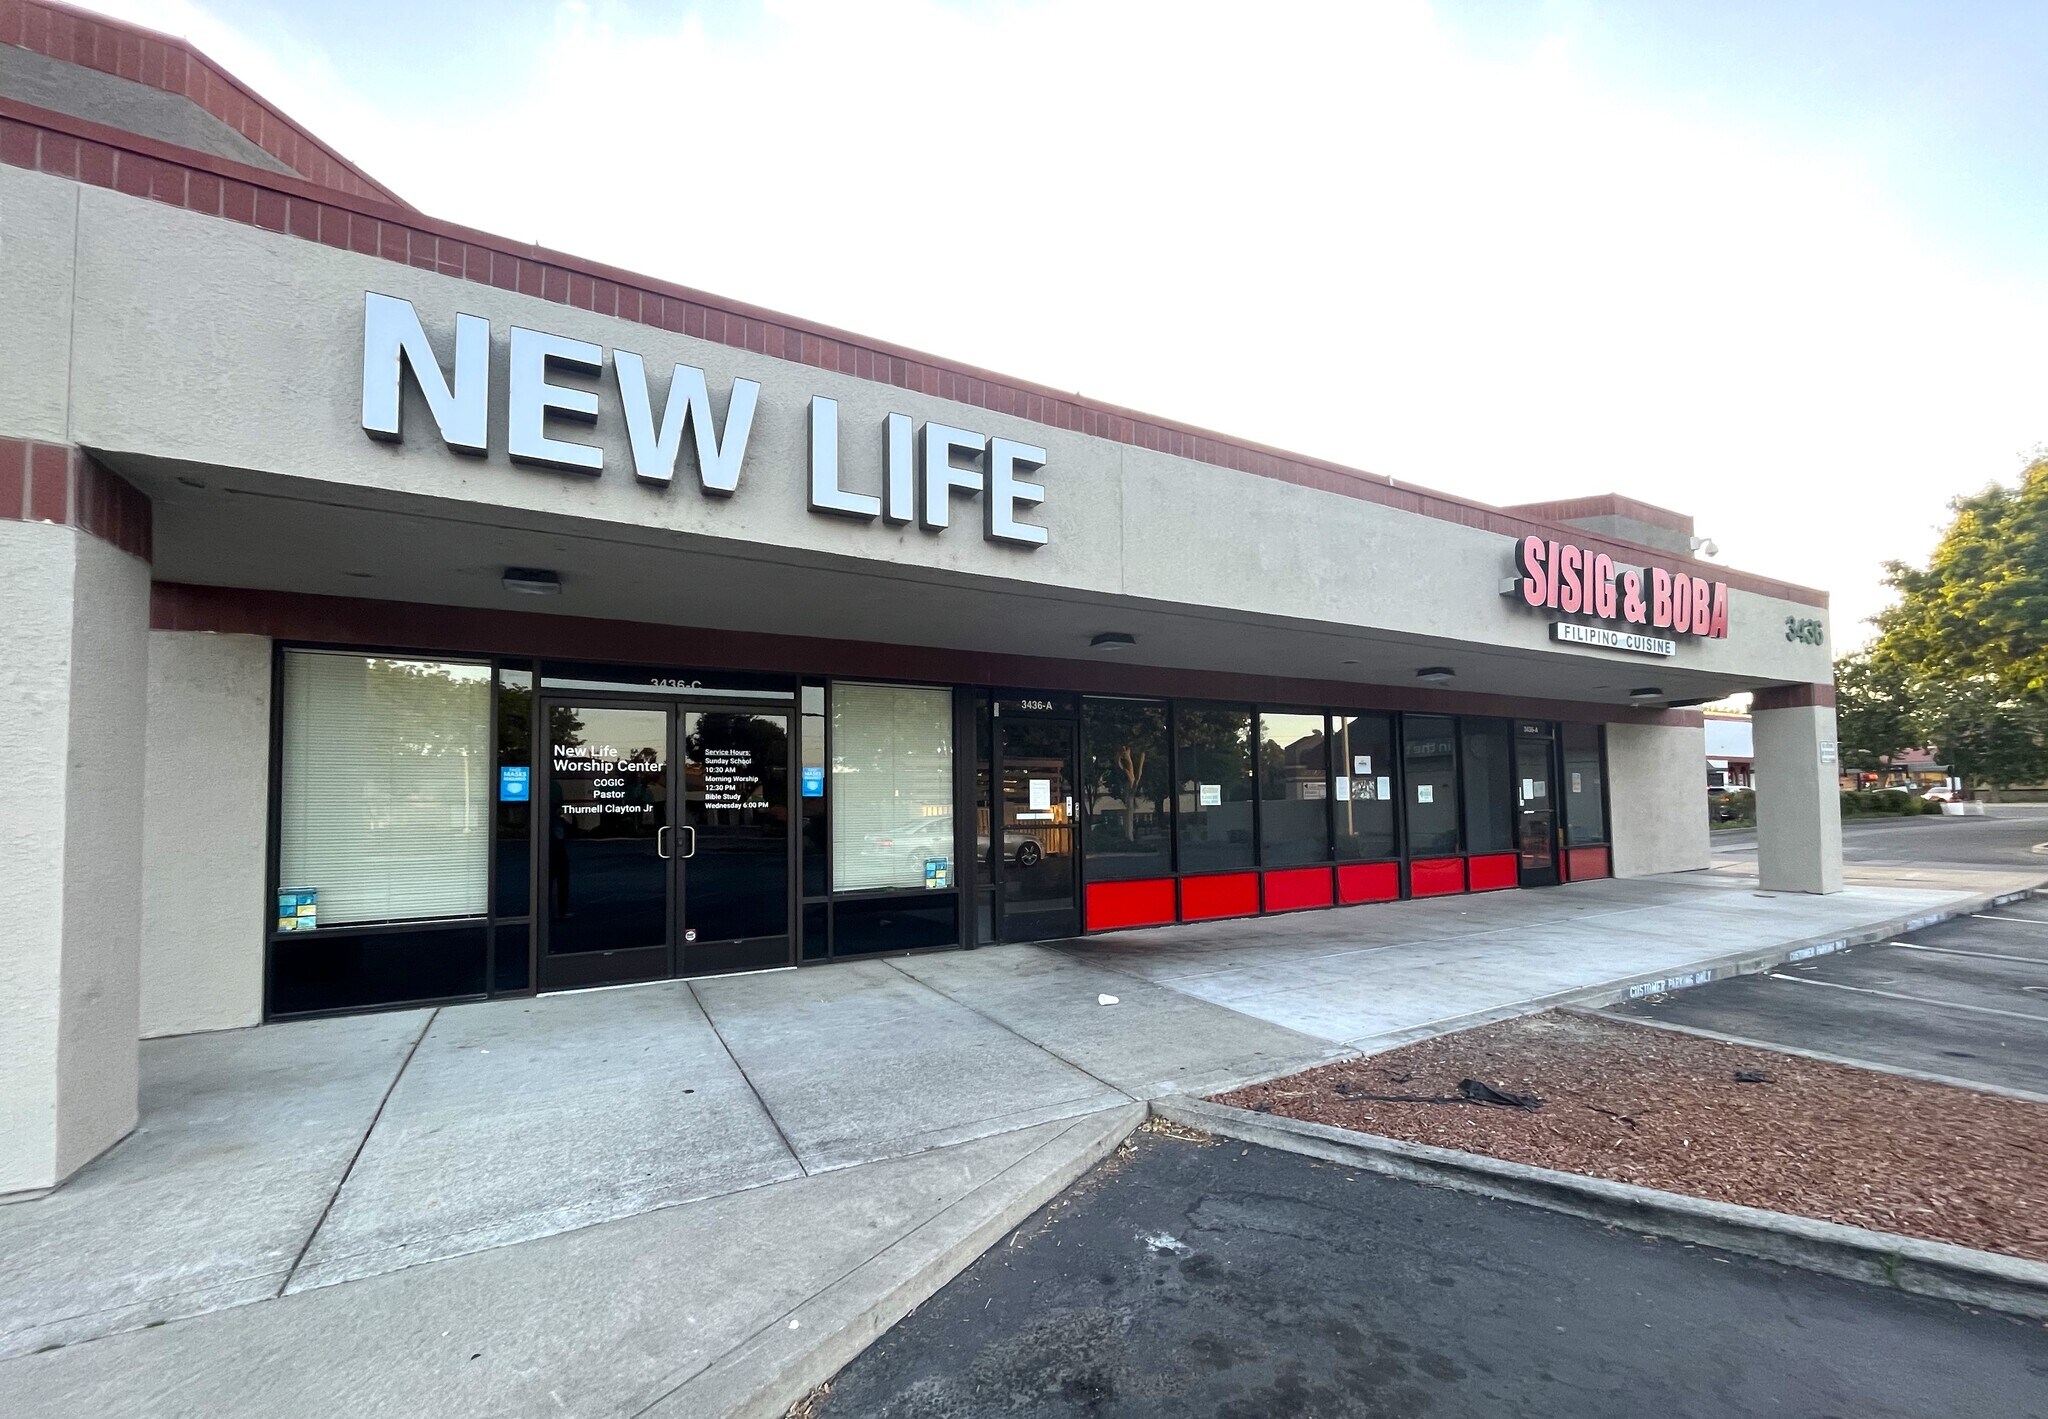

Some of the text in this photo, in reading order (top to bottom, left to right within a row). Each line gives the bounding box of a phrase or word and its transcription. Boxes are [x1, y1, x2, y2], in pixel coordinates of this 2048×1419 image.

[362, 290, 1049, 549] NEW LIFE
[1521, 535, 1728, 639] SISIG & BOBA
[1785, 615, 1824, 646] 3436
[1564, 625, 1671, 654] FILIPINO CUISINE
[1021, 700, 1053, 710] 3436-A
[554, 744, 618, 757] New Life
[553, 759, 664, 774] Worship Center
[705, 757, 752, 765] Sunday School
[593, 778, 625, 787] COGIC
[593, 790, 626, 799] Pastor
[723, 793, 741, 801] Study
[561, 803, 653, 815] Thurnell Clayton Jr
[705, 802, 742, 810] Wednesday
[1629, 980, 1666, 998] CUSTOMER
